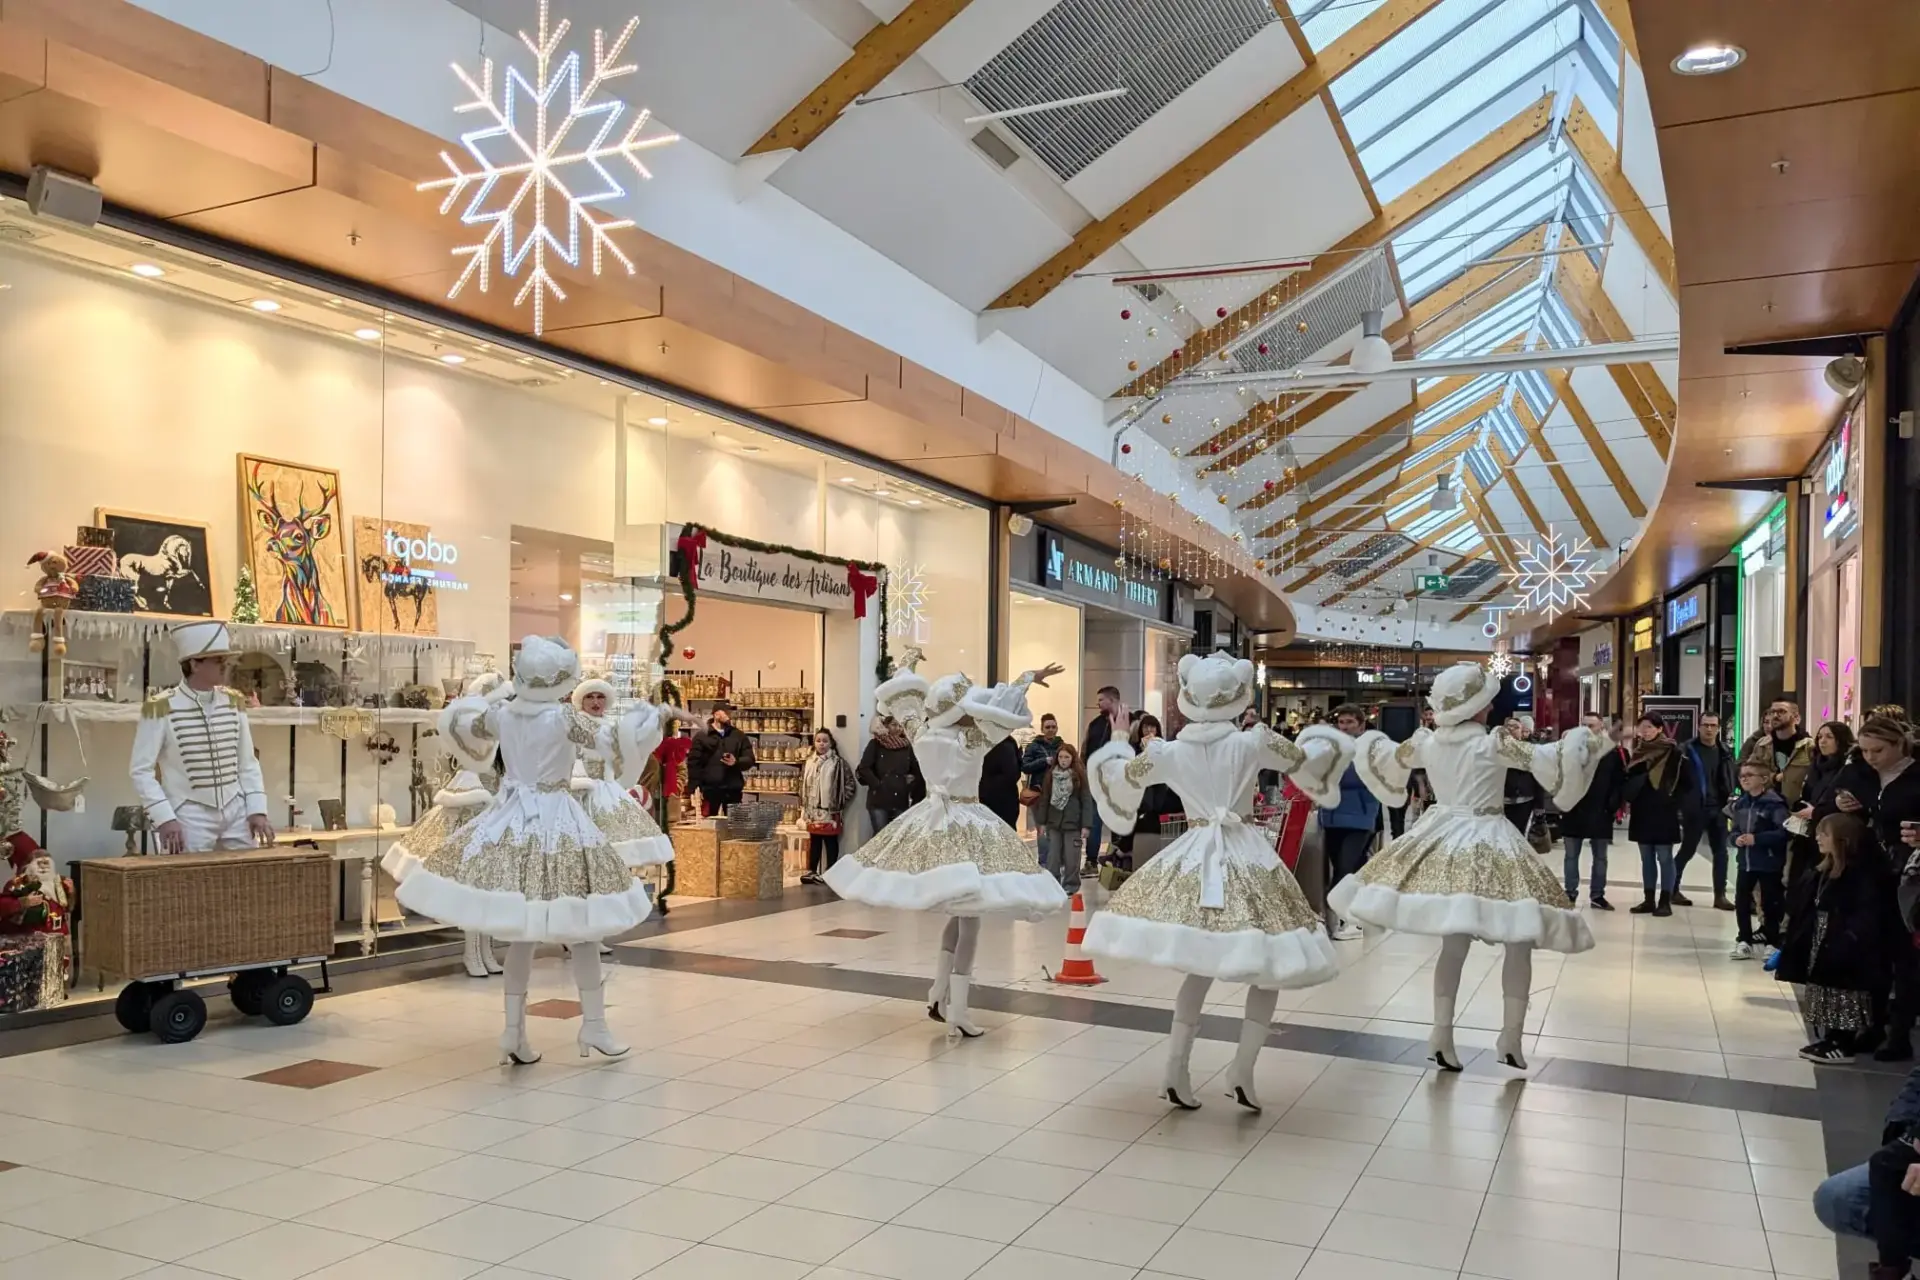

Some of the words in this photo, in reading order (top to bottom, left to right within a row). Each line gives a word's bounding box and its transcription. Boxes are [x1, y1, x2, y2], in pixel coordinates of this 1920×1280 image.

[697, 547, 714, 581] La
[720, 549, 777, 593] Boutique
[781, 563, 802, 588] des
[804, 566, 852, 598] Artisans
[1067, 559, 1118, 594] ARMAND
[1124, 579, 1159, 609] THIERY
